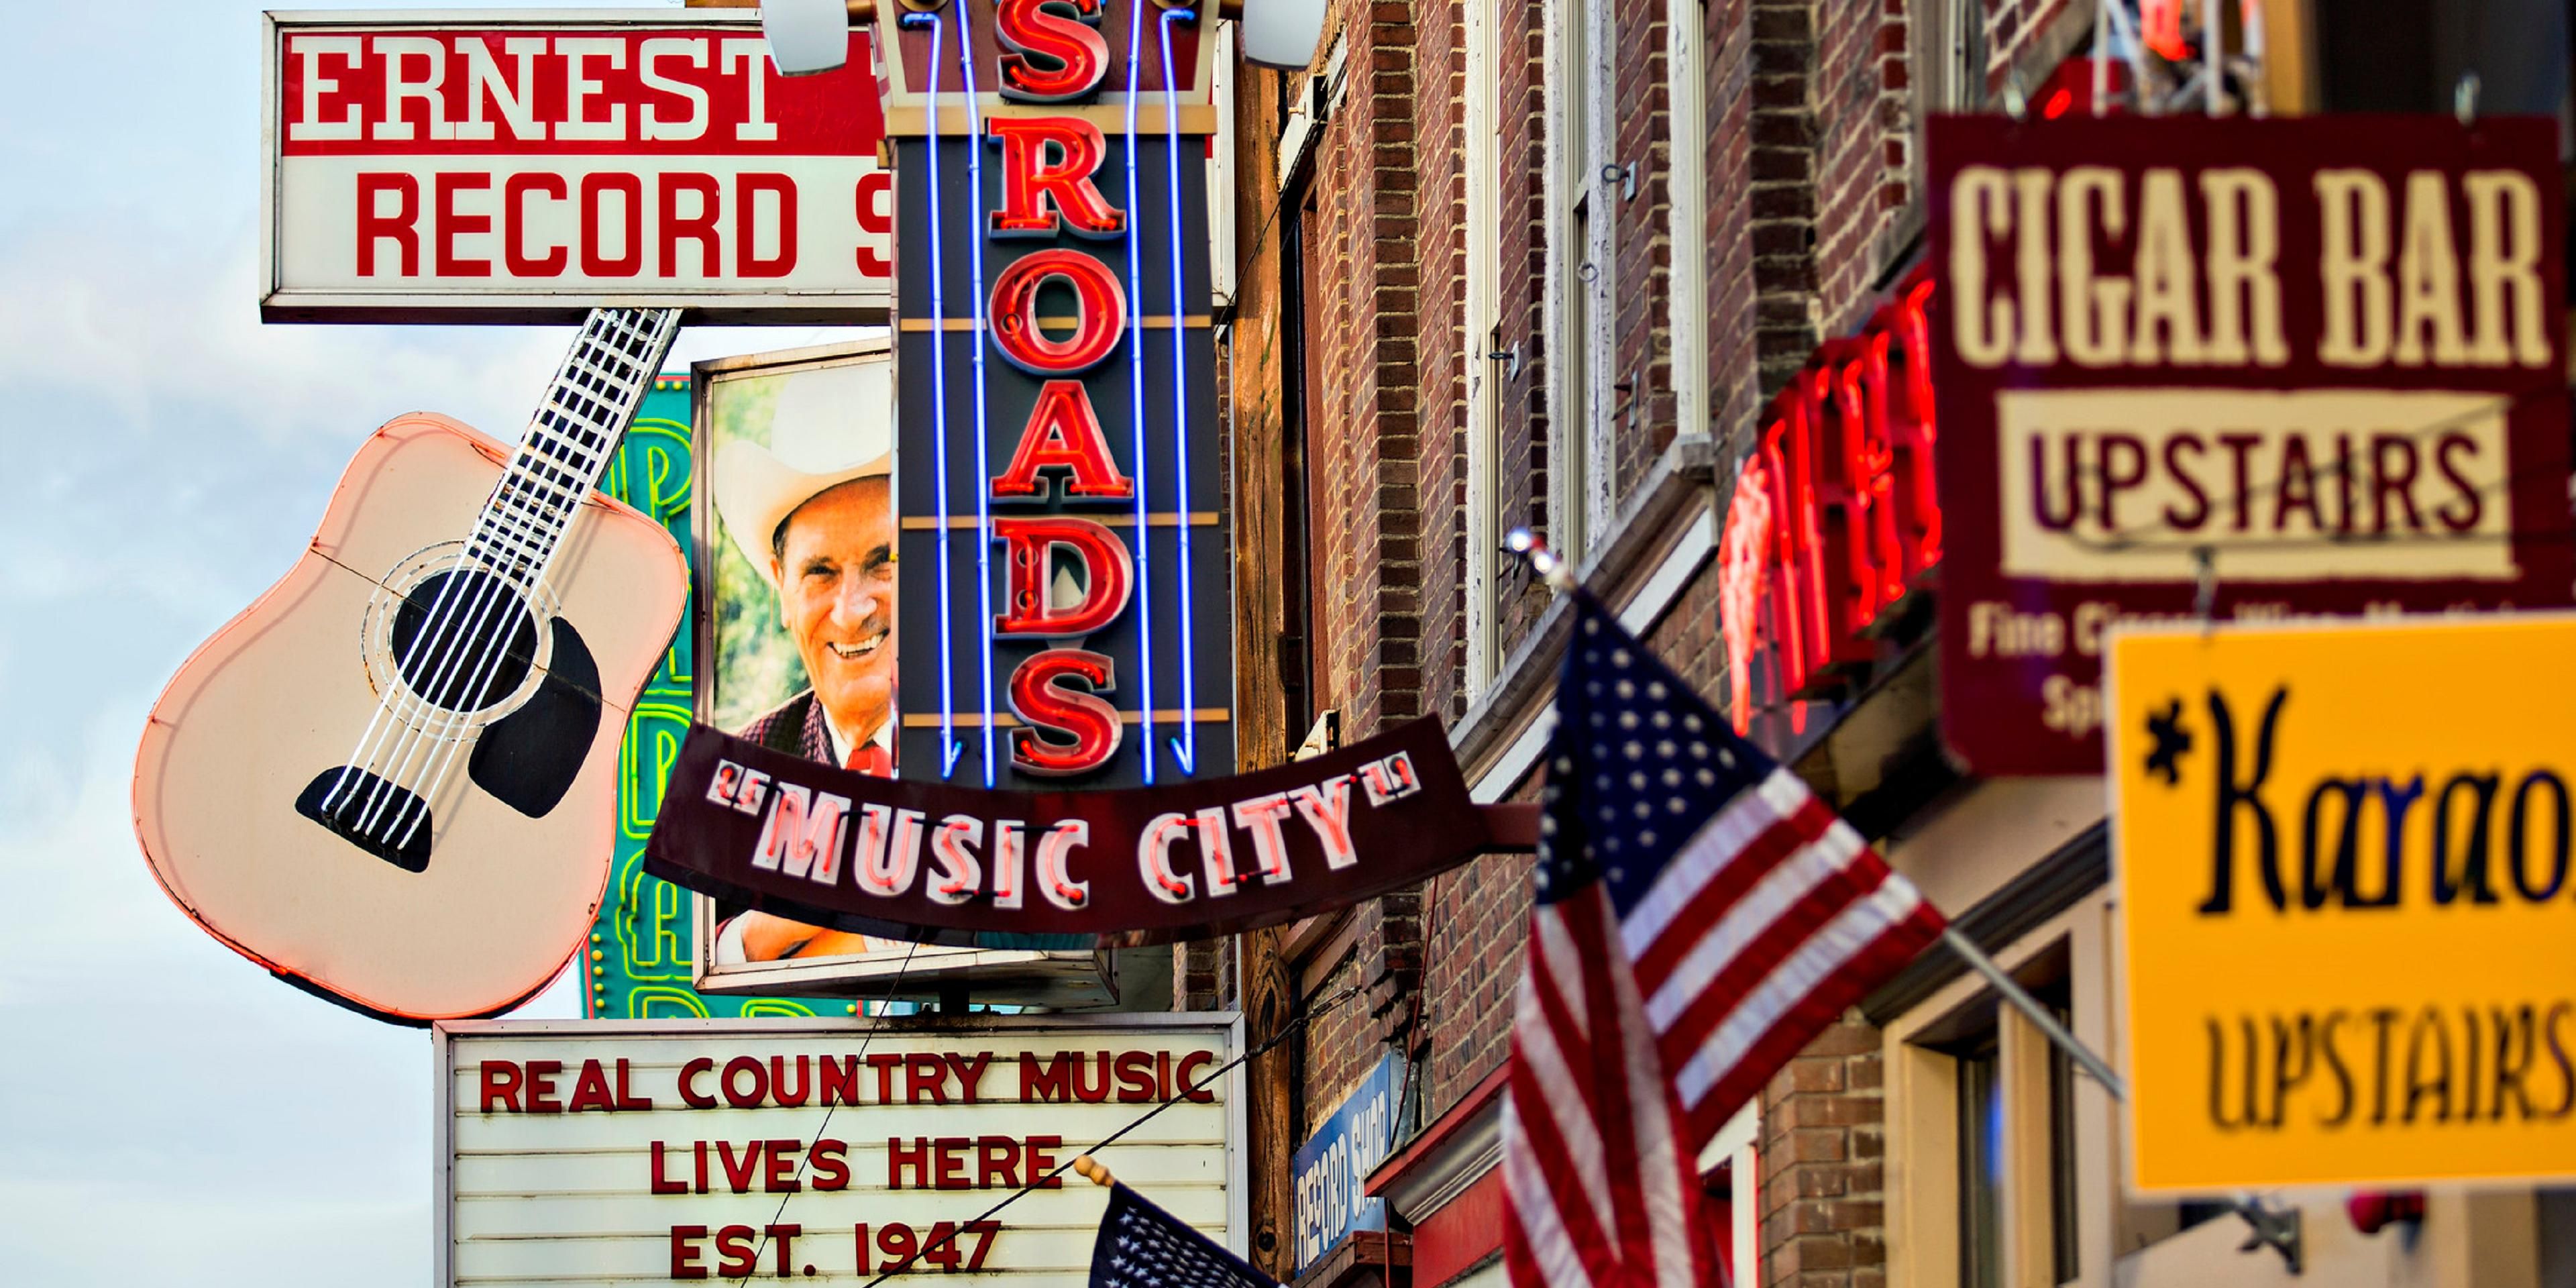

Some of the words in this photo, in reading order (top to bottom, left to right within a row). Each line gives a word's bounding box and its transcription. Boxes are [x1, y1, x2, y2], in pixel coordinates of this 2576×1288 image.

[289, 37, 777, 141] ERNEST
[356, 172, 798, 277] RECORD
[1948, 165, 2290, 369] CIGAR
[2312, 168, 2553, 367] BAR
[2029, 432, 2483, 533] UPSTAIRS
[1968, 600, 2066, 658] Fine
[2144, 684, 2576, 917] Karao
[480, 1059, 652, 1113] REAL
[678, 1051, 994, 1110] COUNTRY
[1019, 1051, 1214, 1104] MUSIC
[2204, 1000, 2576, 1131] UPSTAIRS
[651, 1139, 851, 1194] LIVES
[888, 1135, 1062, 1189] HERE
[1297, 1132, 1348, 1272] RECORD
[671, 1224, 816, 1279] EST.
[855, 1220, 1002, 1277] 1947
